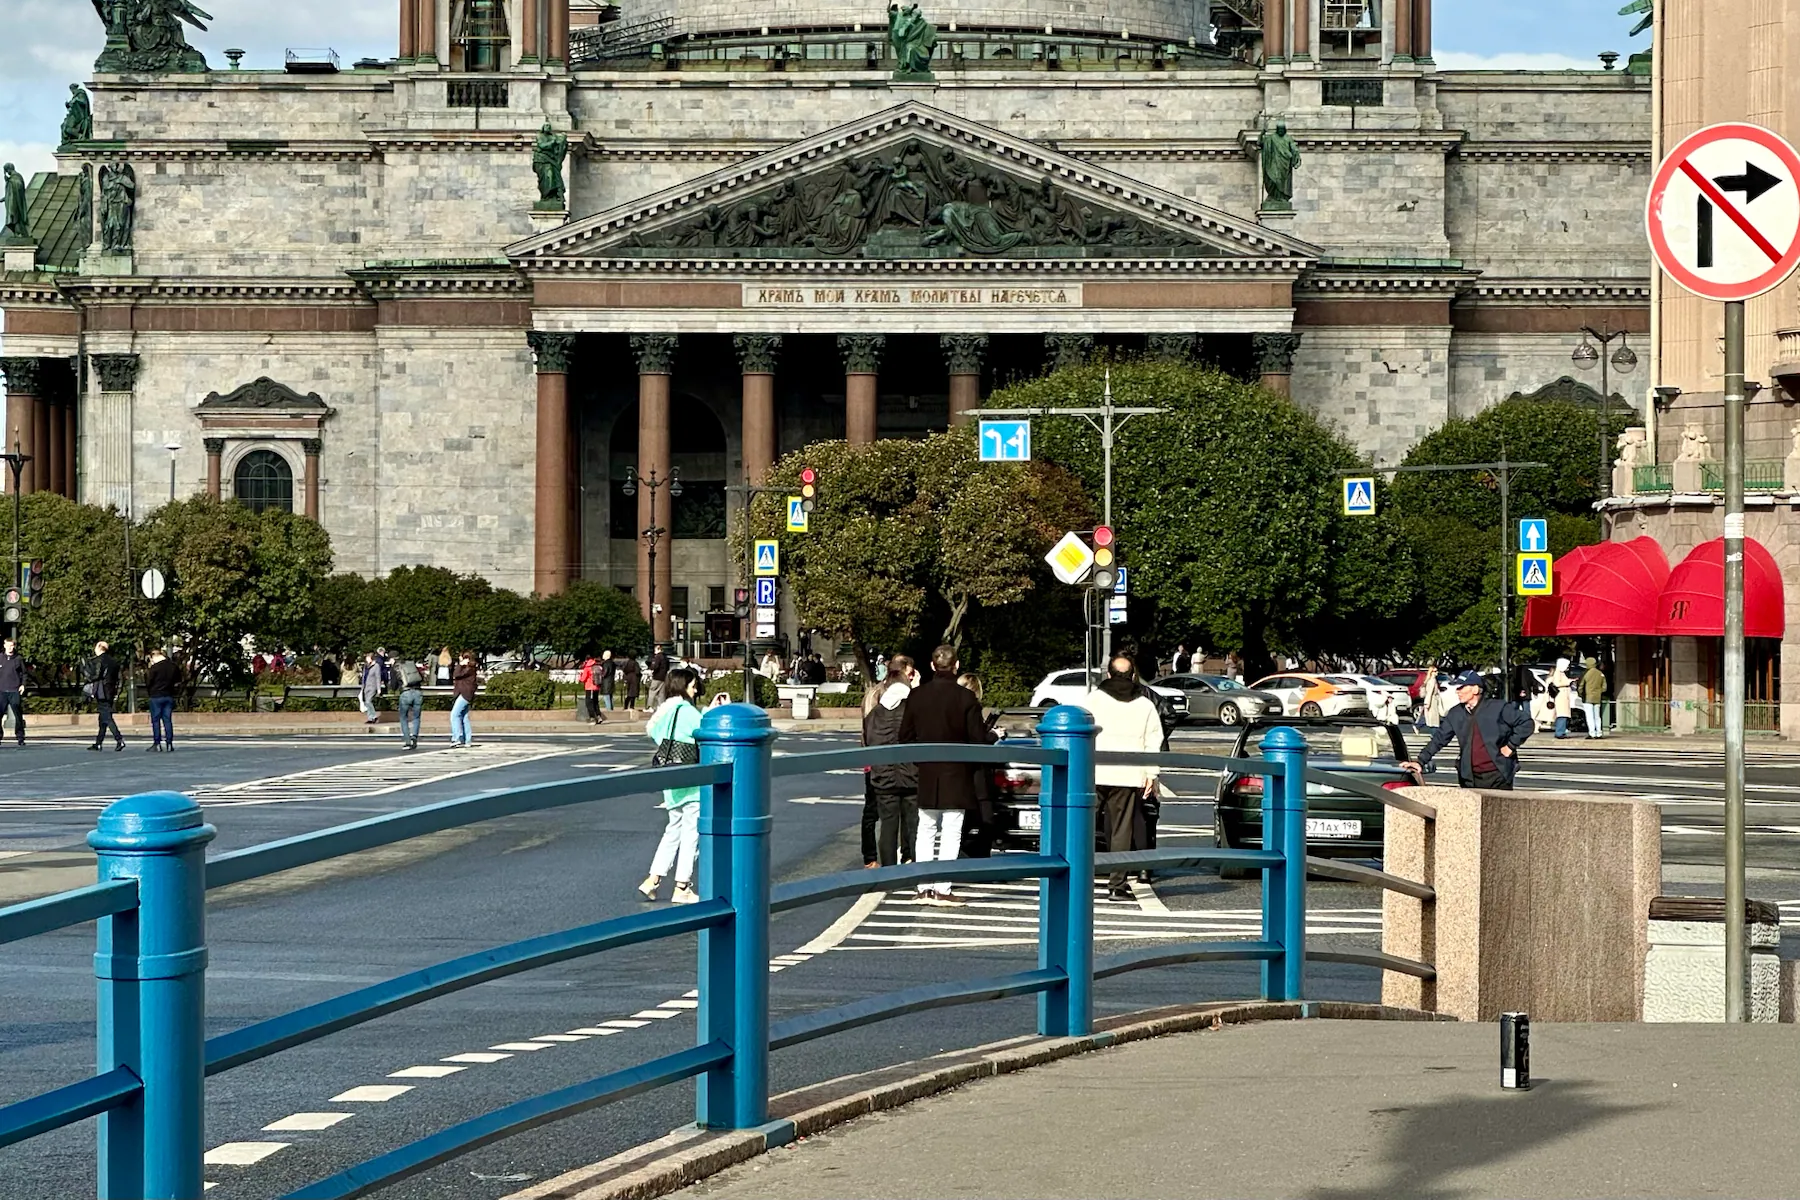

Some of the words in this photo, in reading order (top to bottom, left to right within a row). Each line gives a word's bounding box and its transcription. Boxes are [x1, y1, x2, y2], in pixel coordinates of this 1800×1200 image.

[758, 289, 804, 303] ХРАМЪ
[854, 289, 900, 303] ХРАМЪ
[1343, 821, 1358, 831] 198
